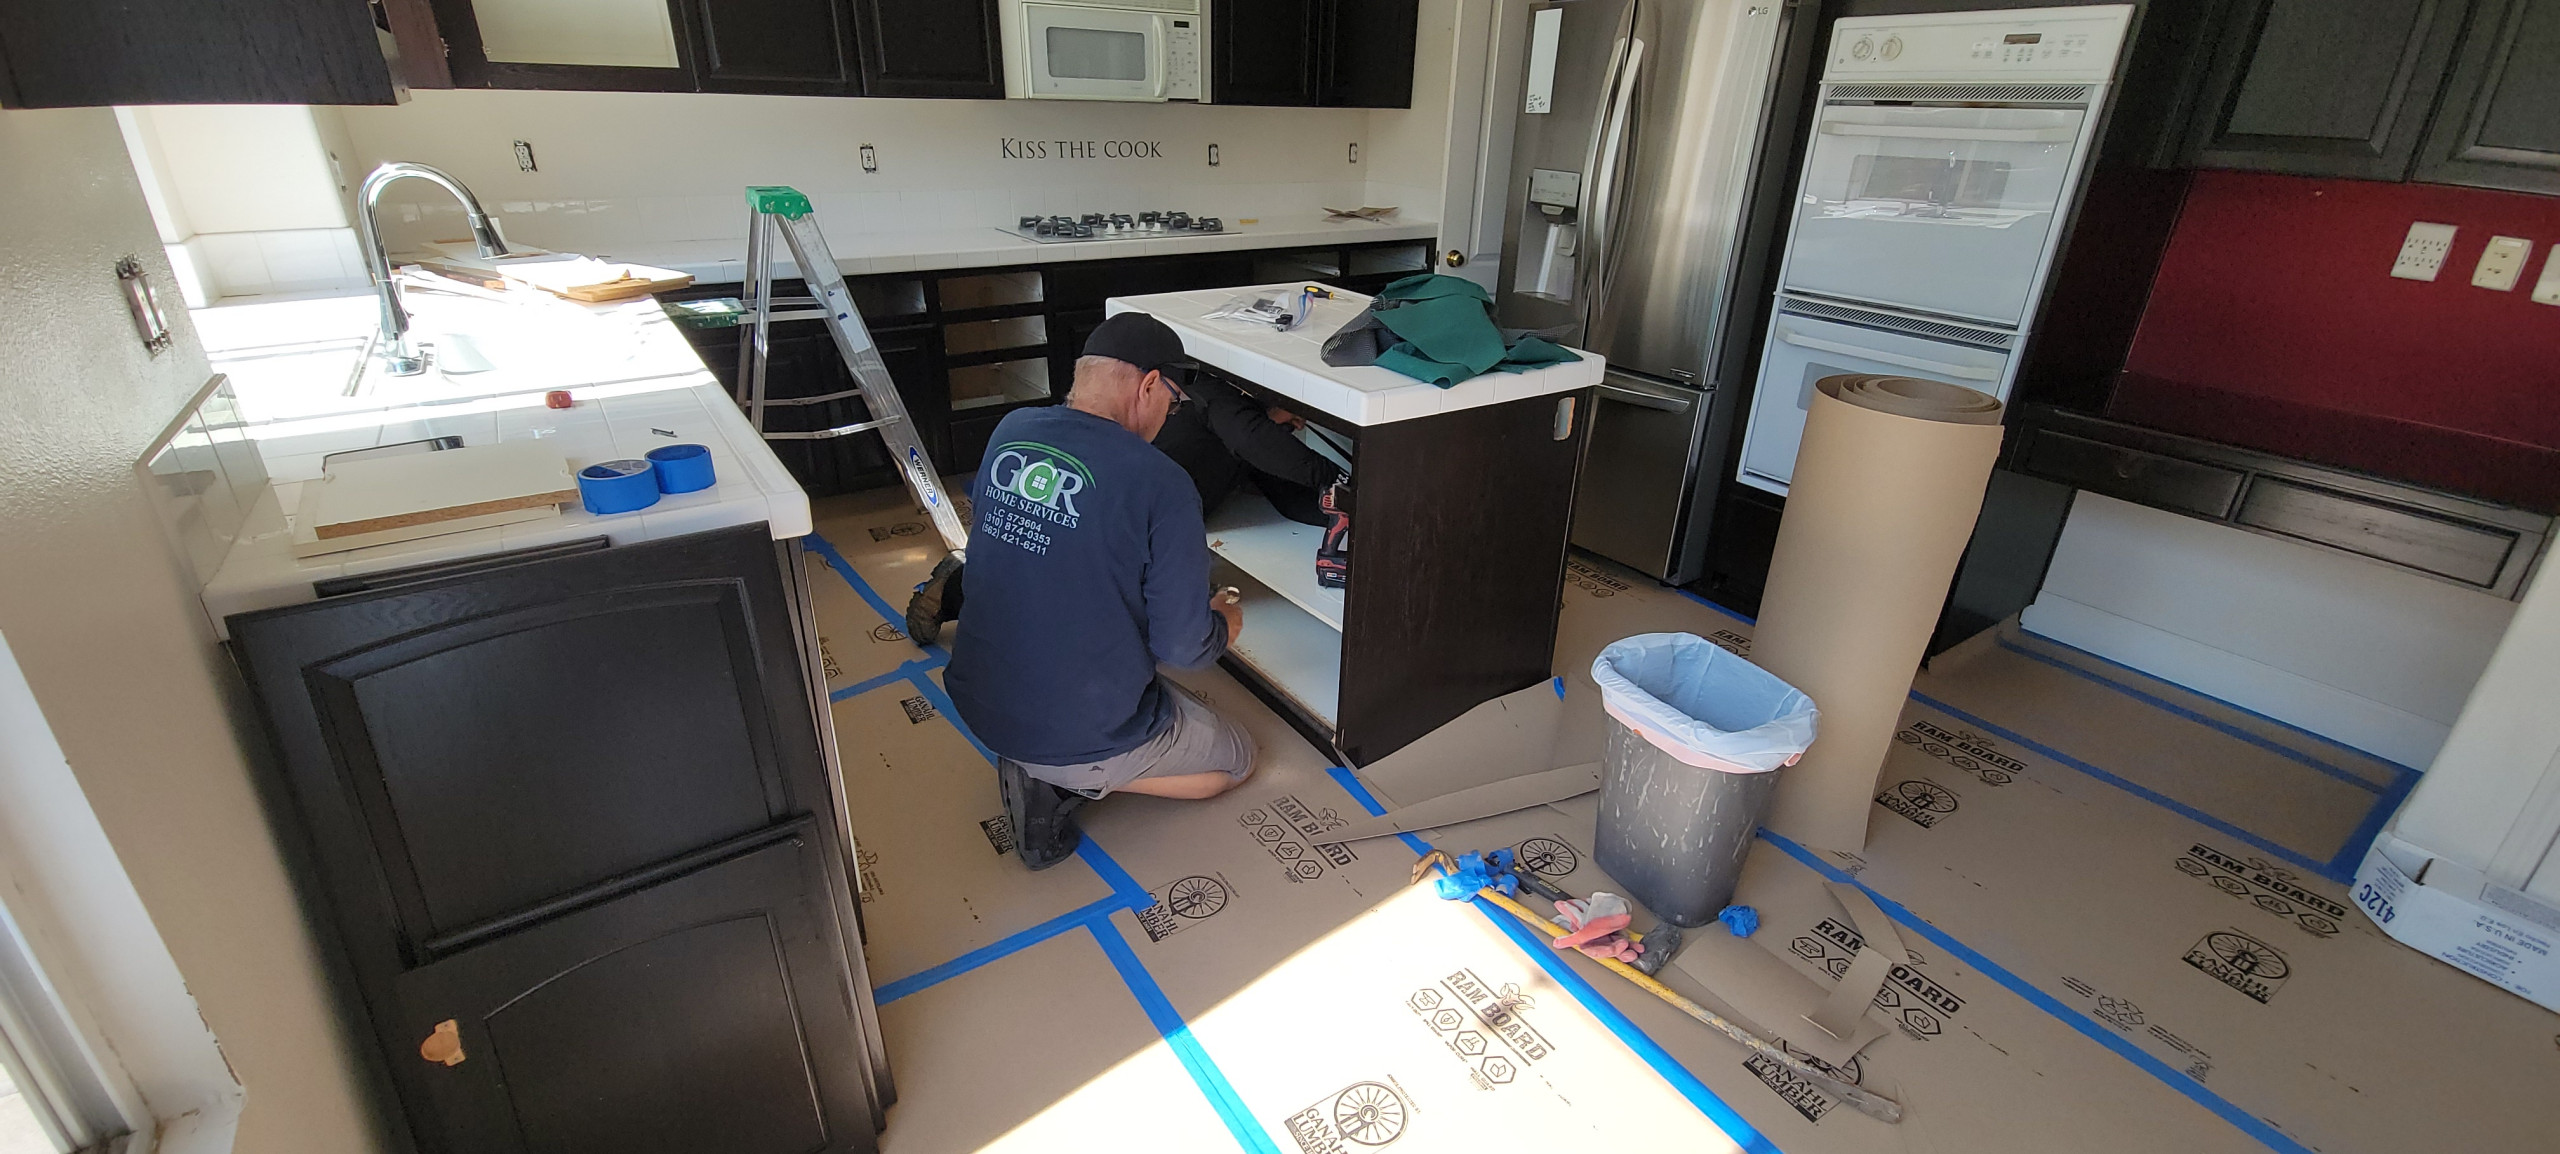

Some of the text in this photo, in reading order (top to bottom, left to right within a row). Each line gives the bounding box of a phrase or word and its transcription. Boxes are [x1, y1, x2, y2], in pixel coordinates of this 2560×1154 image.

[1757, 6, 1769, 15] LG
[1000, 137, 1163, 159] KISS THE COOK
[913, 458, 934, 495] WERNER
[990, 450, 1080, 518] GCR
[985, 485, 1079, 529] HOME SERVICES
[993, 506, 1042, 532] LC 573604
[981, 522, 1048, 556] (562) 421-6211
[984, 511, 1051, 546] (310) 874-0353
[1590, 573, 1629, 591] BOARD
[1714, 629, 1747, 644] RAM
[1912, 721, 2026, 772] RAM BOARD
[1272, 796, 1309, 823] RAM
[2188, 844, 2247, 875] RAM
[2252, 873, 2346, 917] BOARD
[2359, 883, 2396, 924] 412C
[2504, 933, 2516, 943] IN
[2516, 939, 2549, 957] MADE
[1890, 966, 1961, 1014] OARD
[1447, 970, 1489, 1005] RAM
[1480, 1002, 1548, 1061] BOARD
[1750, 1057, 1822, 1118] LUMBER
[1292, 1112, 1332, 1154] LUMB
